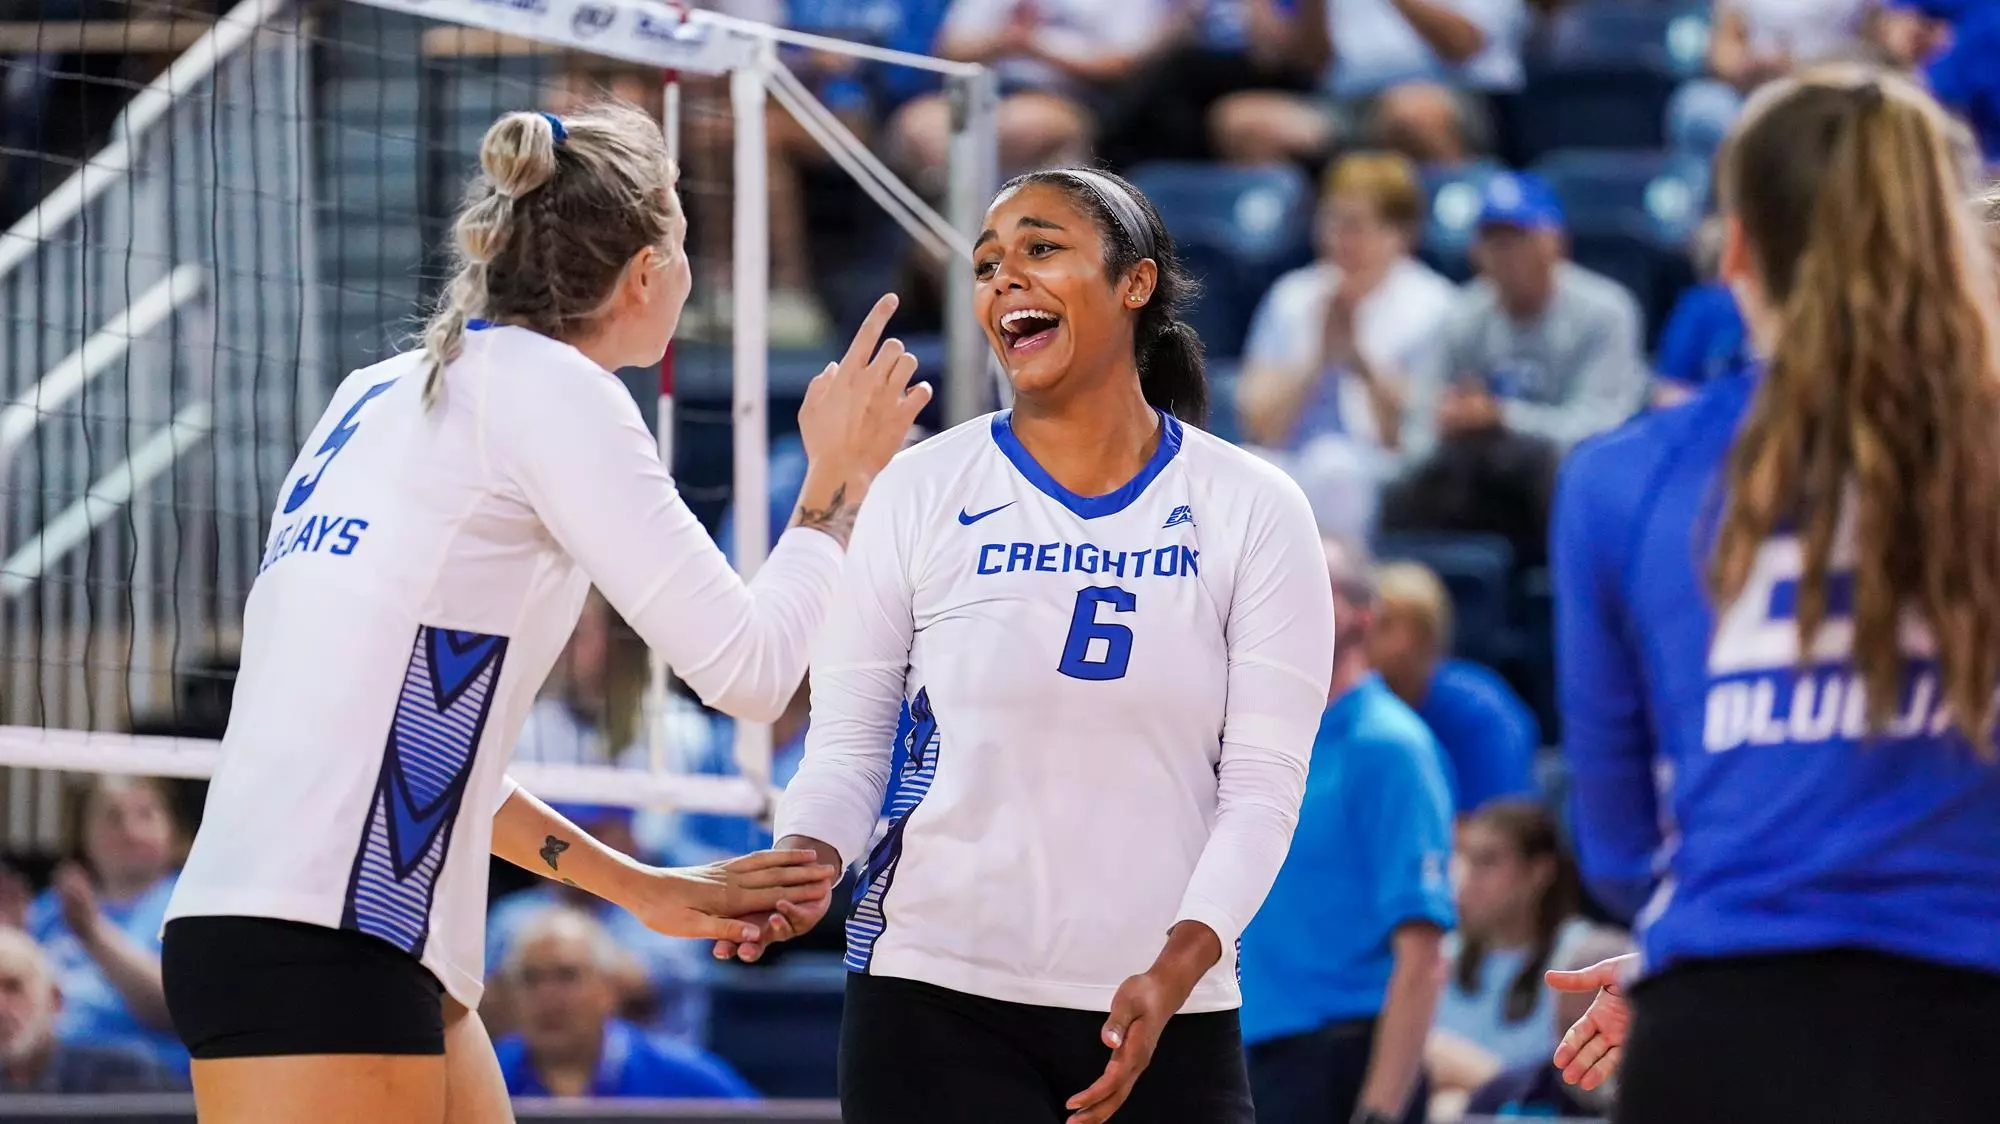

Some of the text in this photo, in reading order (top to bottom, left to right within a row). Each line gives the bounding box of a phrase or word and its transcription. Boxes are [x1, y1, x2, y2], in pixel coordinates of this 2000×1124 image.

[282, 376, 401, 515] 5
[976, 542, 1200, 579] CREIGHTON
[1056, 585, 1137, 682] 6
